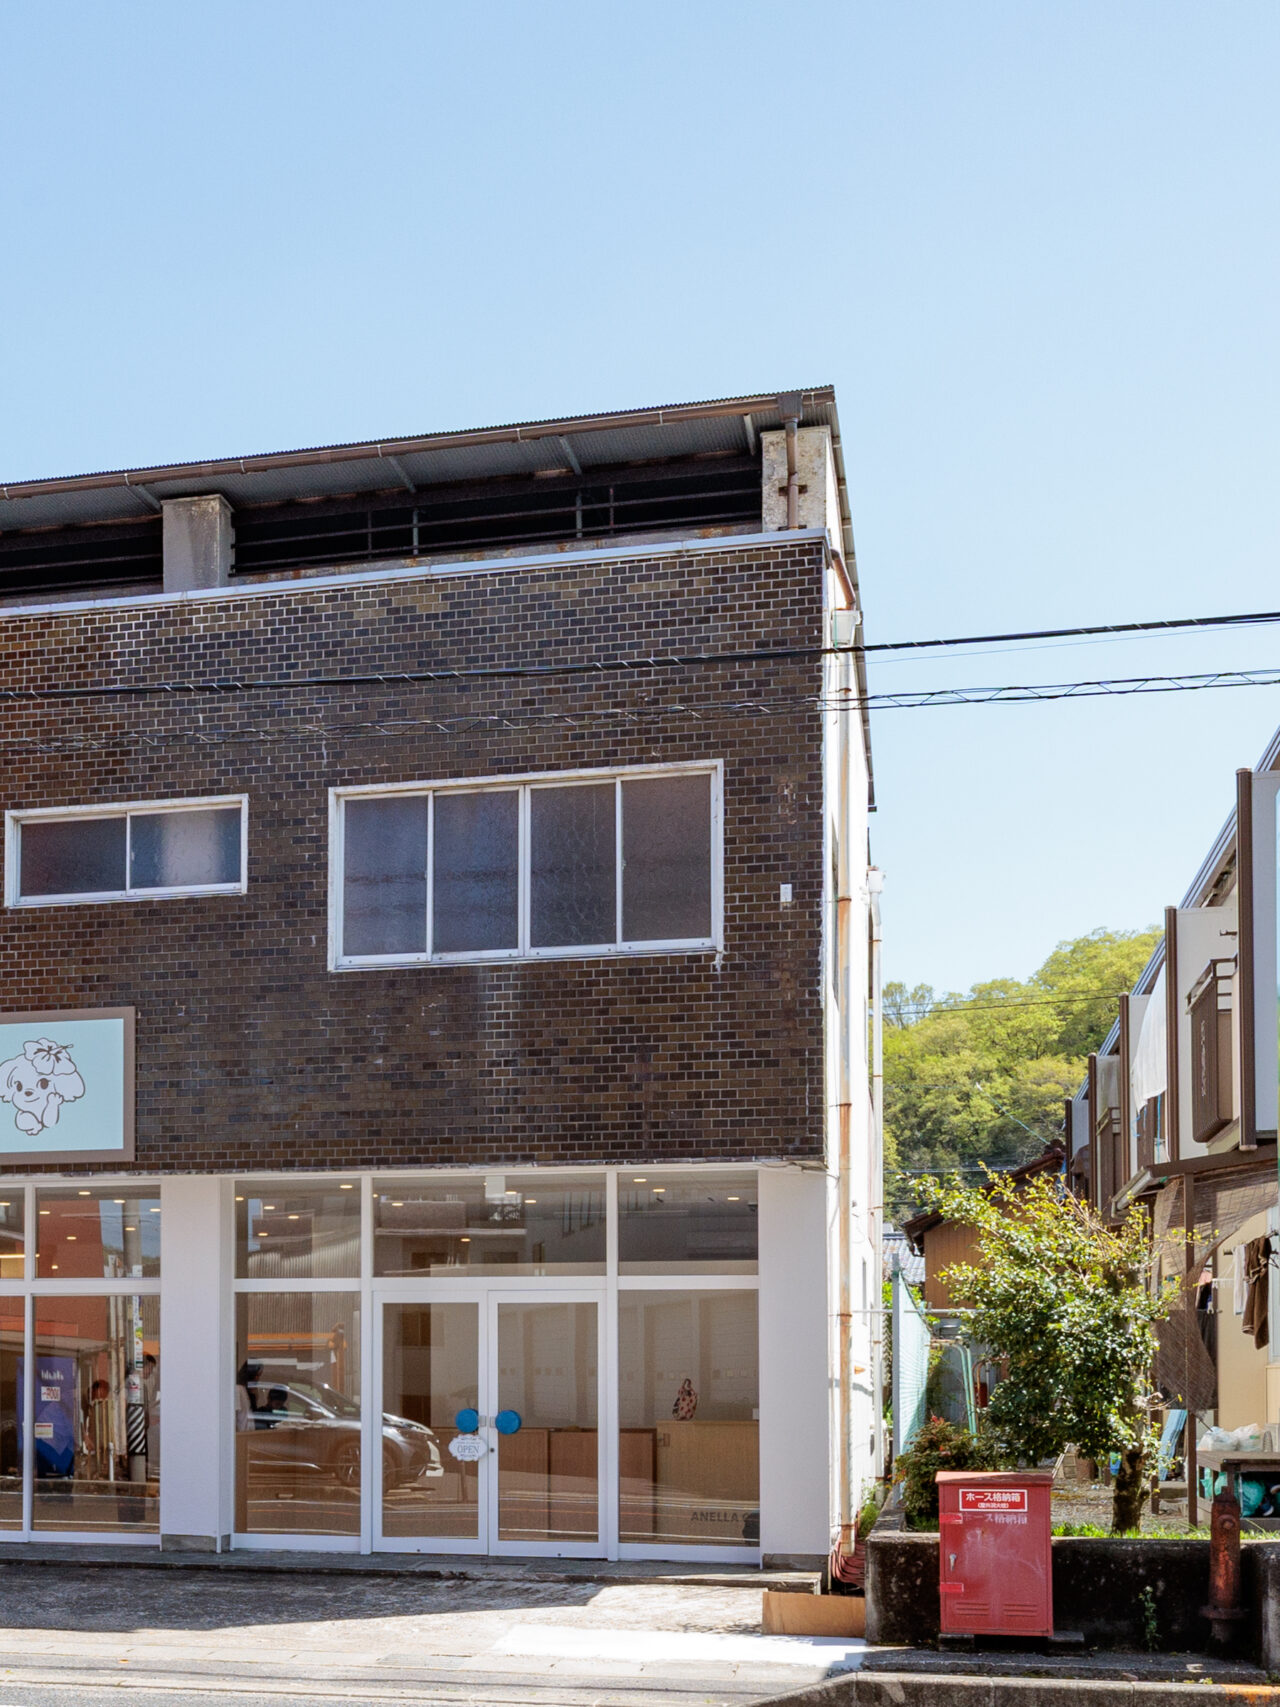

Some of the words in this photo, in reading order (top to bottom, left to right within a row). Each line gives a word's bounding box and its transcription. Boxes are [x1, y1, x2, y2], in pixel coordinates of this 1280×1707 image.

[457, 1445, 480, 1453] OPEN
[965, 1492, 1021, 1502] ホース格納箱
[691, 1511, 739, 1522] ANELLA
